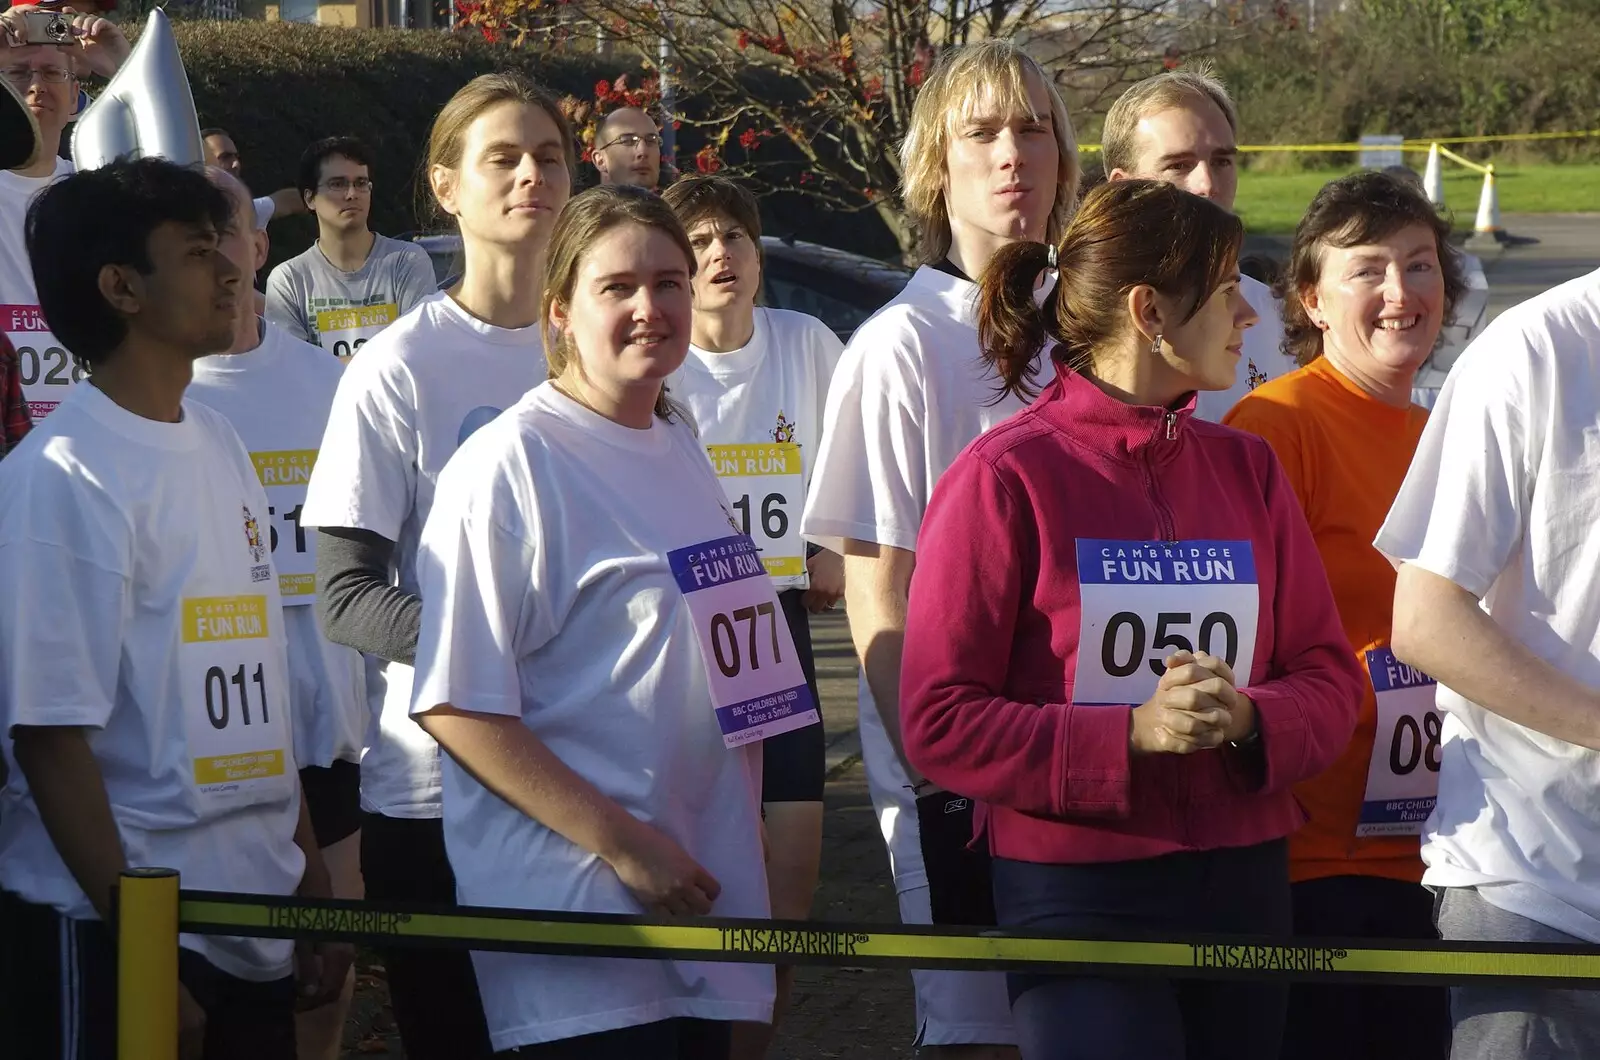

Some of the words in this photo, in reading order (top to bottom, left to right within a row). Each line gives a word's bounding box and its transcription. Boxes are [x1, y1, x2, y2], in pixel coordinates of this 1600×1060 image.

[12, 317, 49, 330] FUN
[328, 318, 357, 329] FUN
[360, 314, 389, 325] RUN
[263, 464, 310, 483] RUN
[745, 458, 786, 474] RUN
[733, 492, 789, 539] 16
[1101, 548, 1231, 558] CAMBRIDGE
[692, 559, 733, 586] FUN
[734, 553, 760, 576] RUN
[1102, 560, 1163, 581] FUN
[1173, 560, 1235, 581] RUN
[197, 617, 233, 638] FUN
[235, 615, 262, 635] RUN
[710, 601, 781, 678] 077
[1101, 611, 1238, 677] 050
[1387, 666, 1422, 687] FUN
[205, 662, 269, 730] 011
[732, 705, 747, 717] BBC
[747, 697, 778, 712] CHILDREN
[778, 694, 784, 704] IN
[784, 690, 798, 701] NEED
[747, 711, 767, 724] Raise
[768, 711, 773, 719] a
[772, 704, 793, 718] Smile!
[1389, 711, 1442, 776] 08
[1386, 801, 1404, 811] BBC
[1400, 810, 1426, 820] Raise
